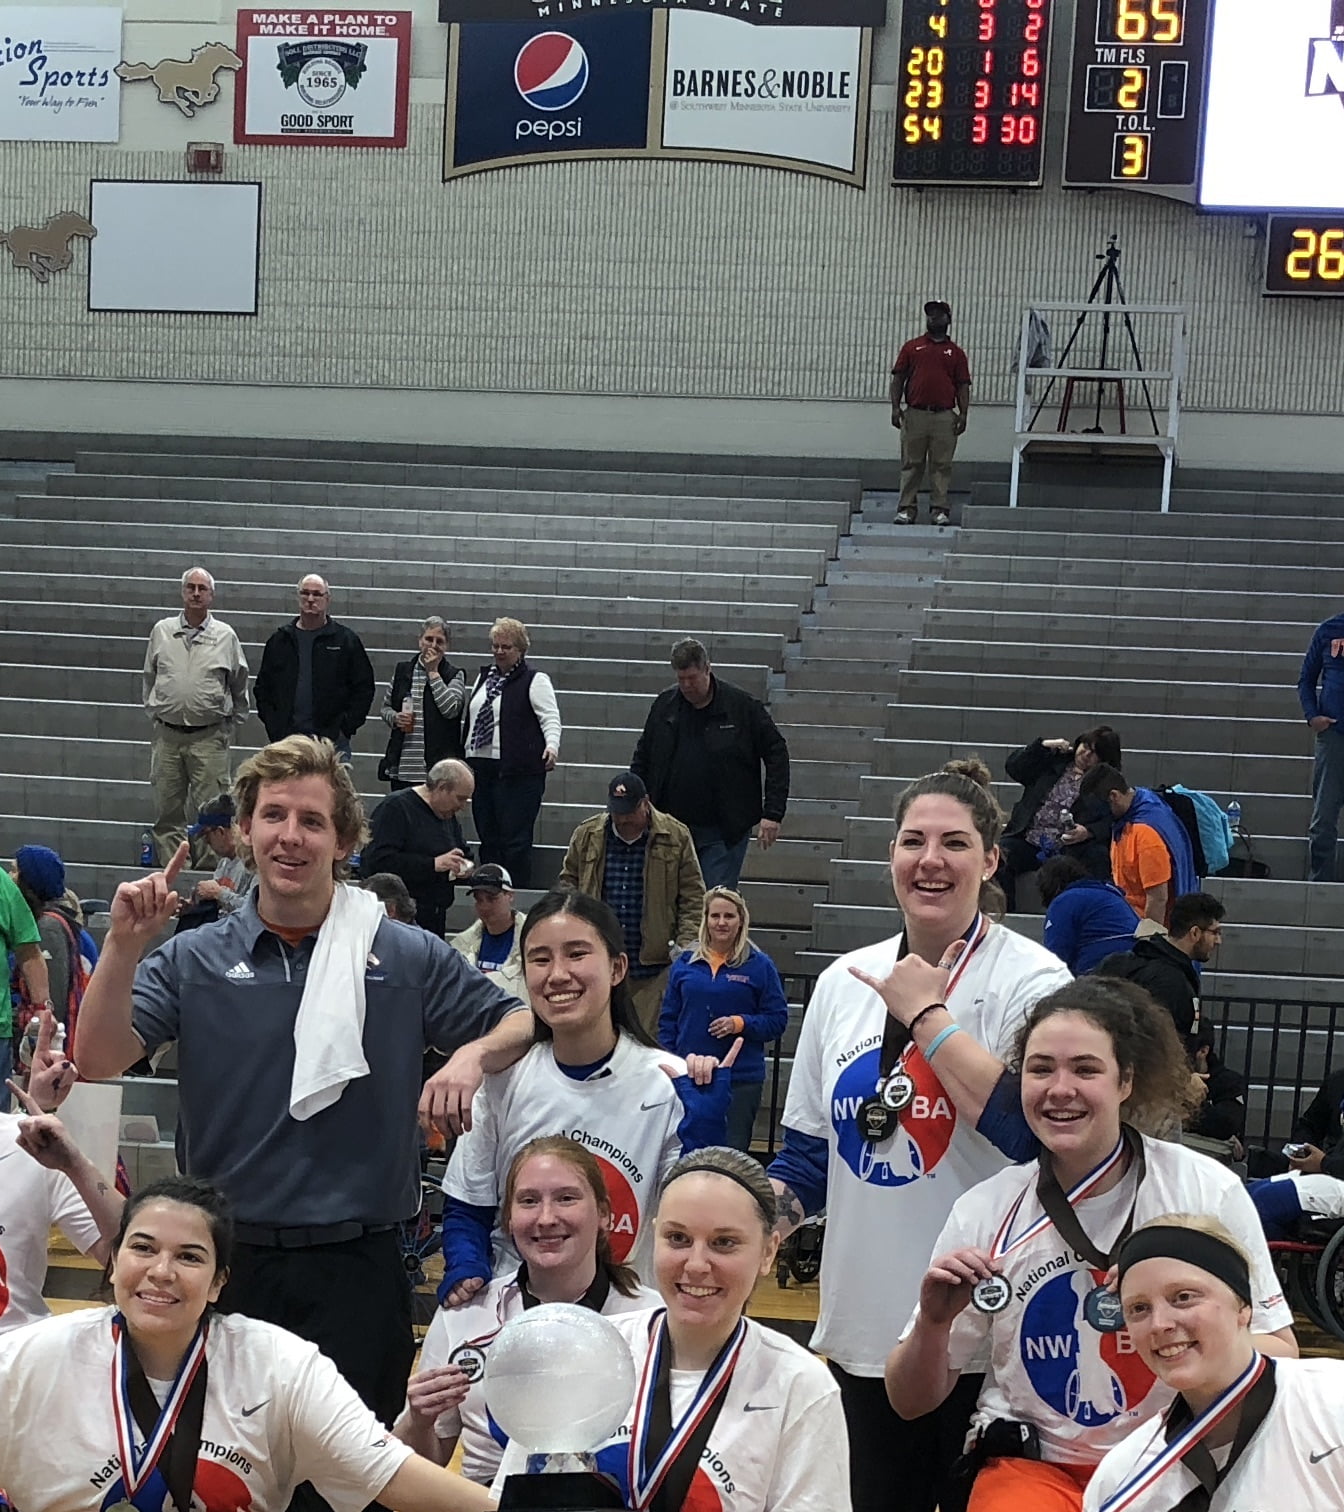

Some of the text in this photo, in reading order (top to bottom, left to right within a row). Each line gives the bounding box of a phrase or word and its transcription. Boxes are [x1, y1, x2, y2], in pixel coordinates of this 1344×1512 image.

[253, 14, 397, 25] MAKE A PLAN TO
[260, 25, 308, 35] MAKE
[314, 25, 331, 35] IT
[928, 12, 1042, 41] 4 3 2
[1117, 0, 1178, 41] 65
[907, 47, 1039, 76] 20 1 6
[1095, 48, 1146, 63] TM FLS
[19, 55, 109, 97] Sports
[306, 77, 338, 88] 1965
[1117, 68, 1143, 108] 2
[42, 97, 62, 113] Way
[65, 97, 75, 107] to
[905, 79, 1037, 109] 23 3 14
[281, 114, 354, 128] GOOD SPORT
[516, 117, 583, 140] pepsi
[904, 114, 1035, 143] 54 3 30
[1116, 115, 1155, 131] T.O.L.
[1122, 136, 1143, 176] 3
[912, 1096, 953, 1120] BA
[571, 1129, 644, 1185] Champions
[1016, 1253, 1071, 1302] National
[1026, 1335, 1072, 1361] NW
